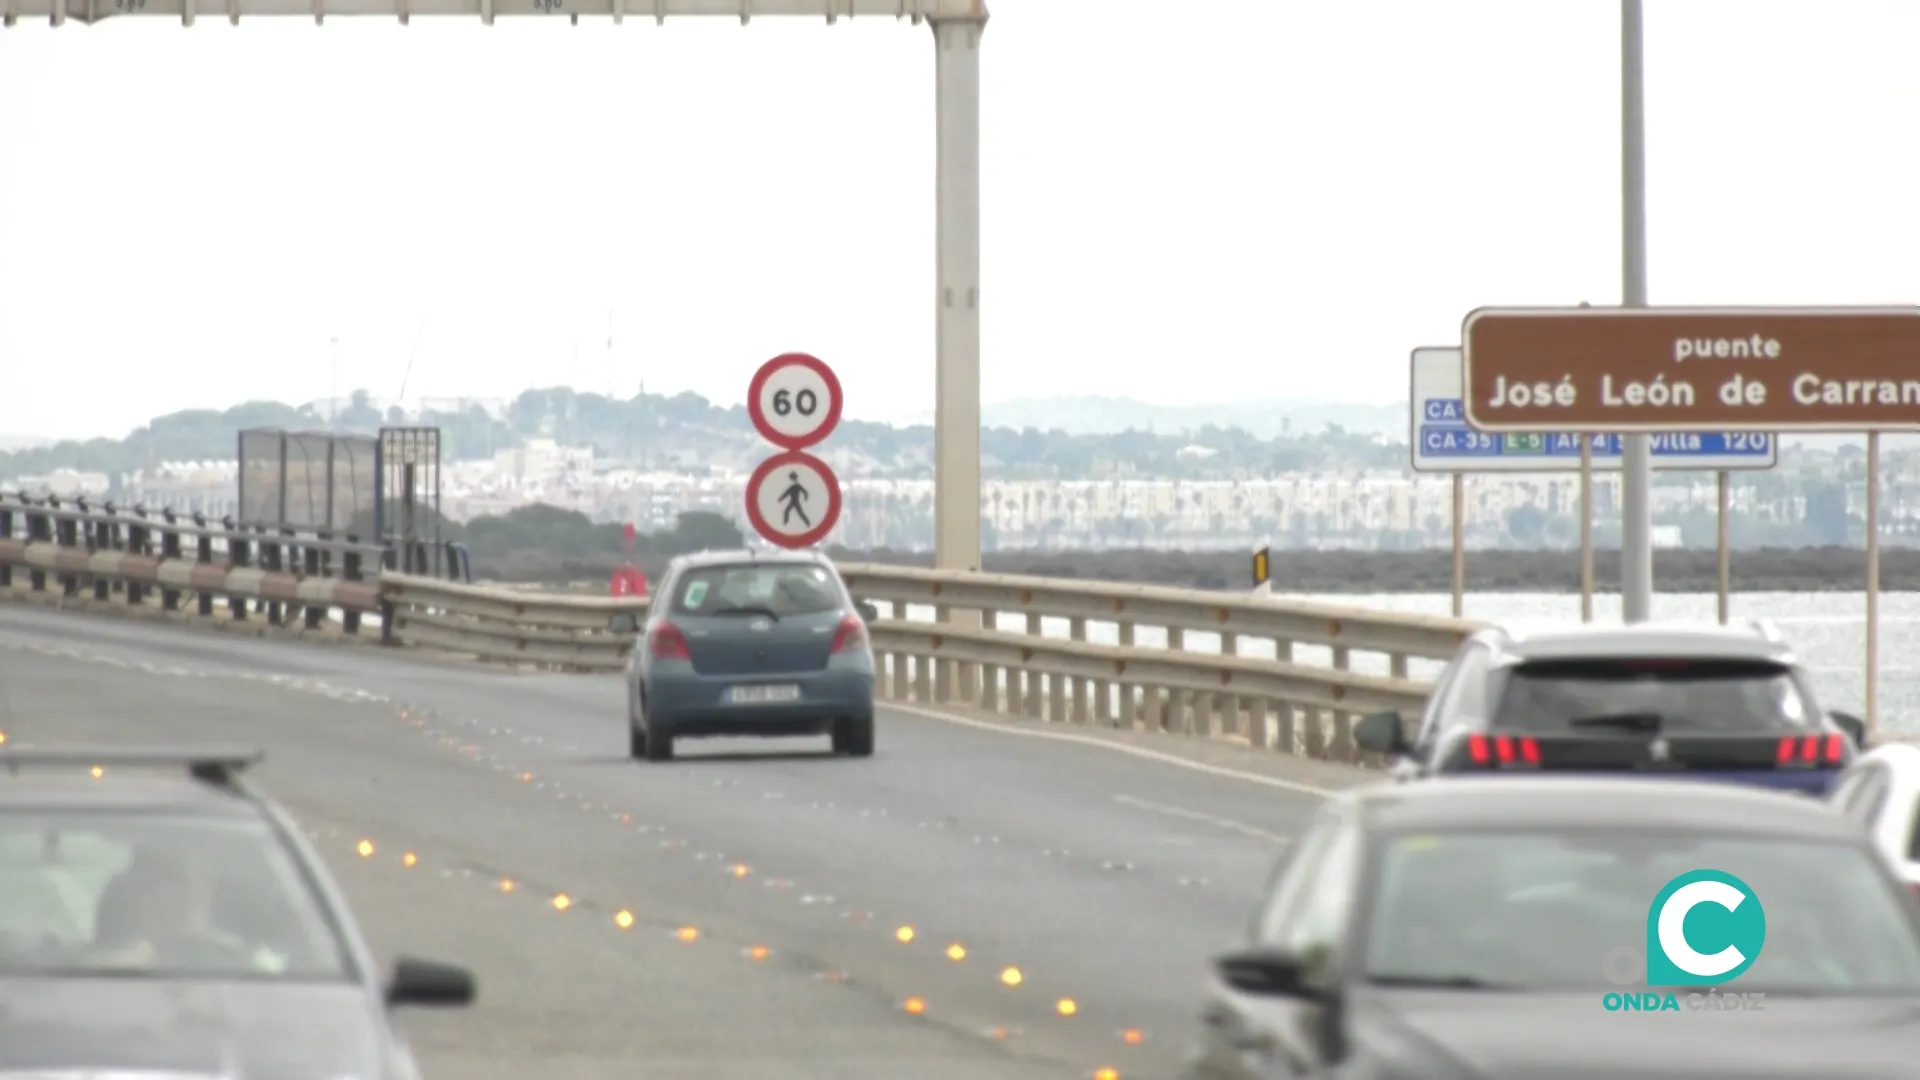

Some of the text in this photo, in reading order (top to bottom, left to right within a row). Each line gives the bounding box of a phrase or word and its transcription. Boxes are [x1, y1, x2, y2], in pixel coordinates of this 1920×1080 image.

[1676, 333, 1781, 362] puente
[773, 389, 817, 416] 60
[1489, 372, 1920, 407] José León de Carran
[1427, 402, 1464, 419] CA-
[1427, 432, 1493, 449] CA-35
[1507, 432, 1541, 448] E-5
[1557, 432, 1606, 449] AP4
[1722, 431, 1767, 450] 120
